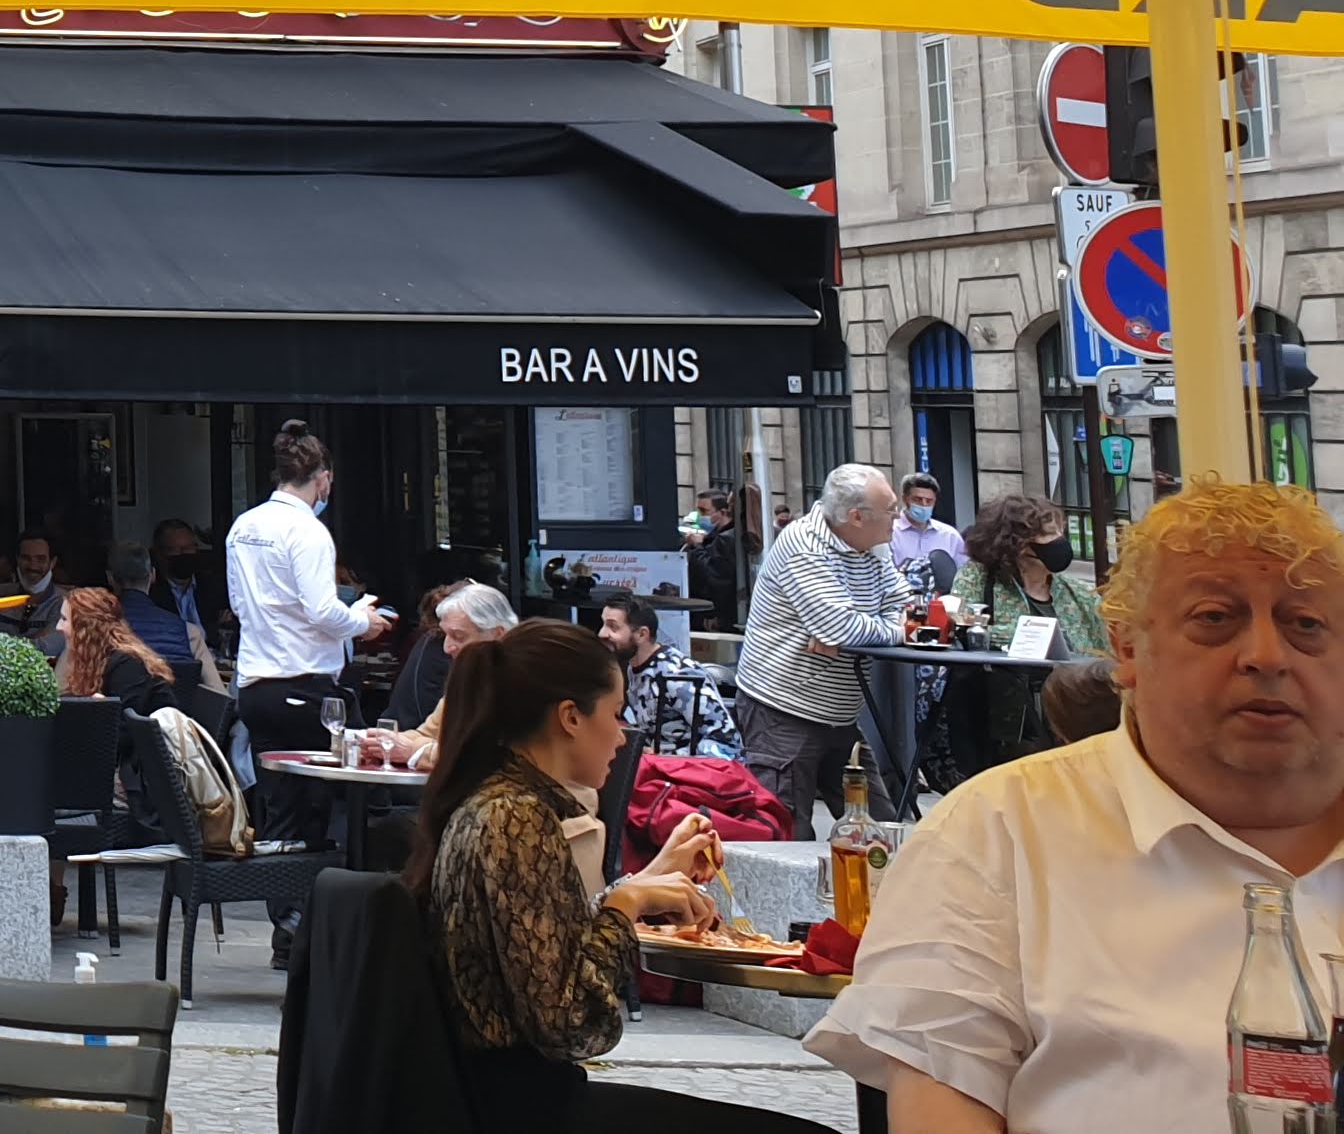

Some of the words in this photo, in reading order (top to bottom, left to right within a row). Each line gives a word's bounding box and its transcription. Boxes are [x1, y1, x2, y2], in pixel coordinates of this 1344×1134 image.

[1076, 194, 1113, 213] SAUF
[500, 347, 574, 383] BAR
[582, 347, 608, 383] A
[614, 347, 700, 383] VINS
